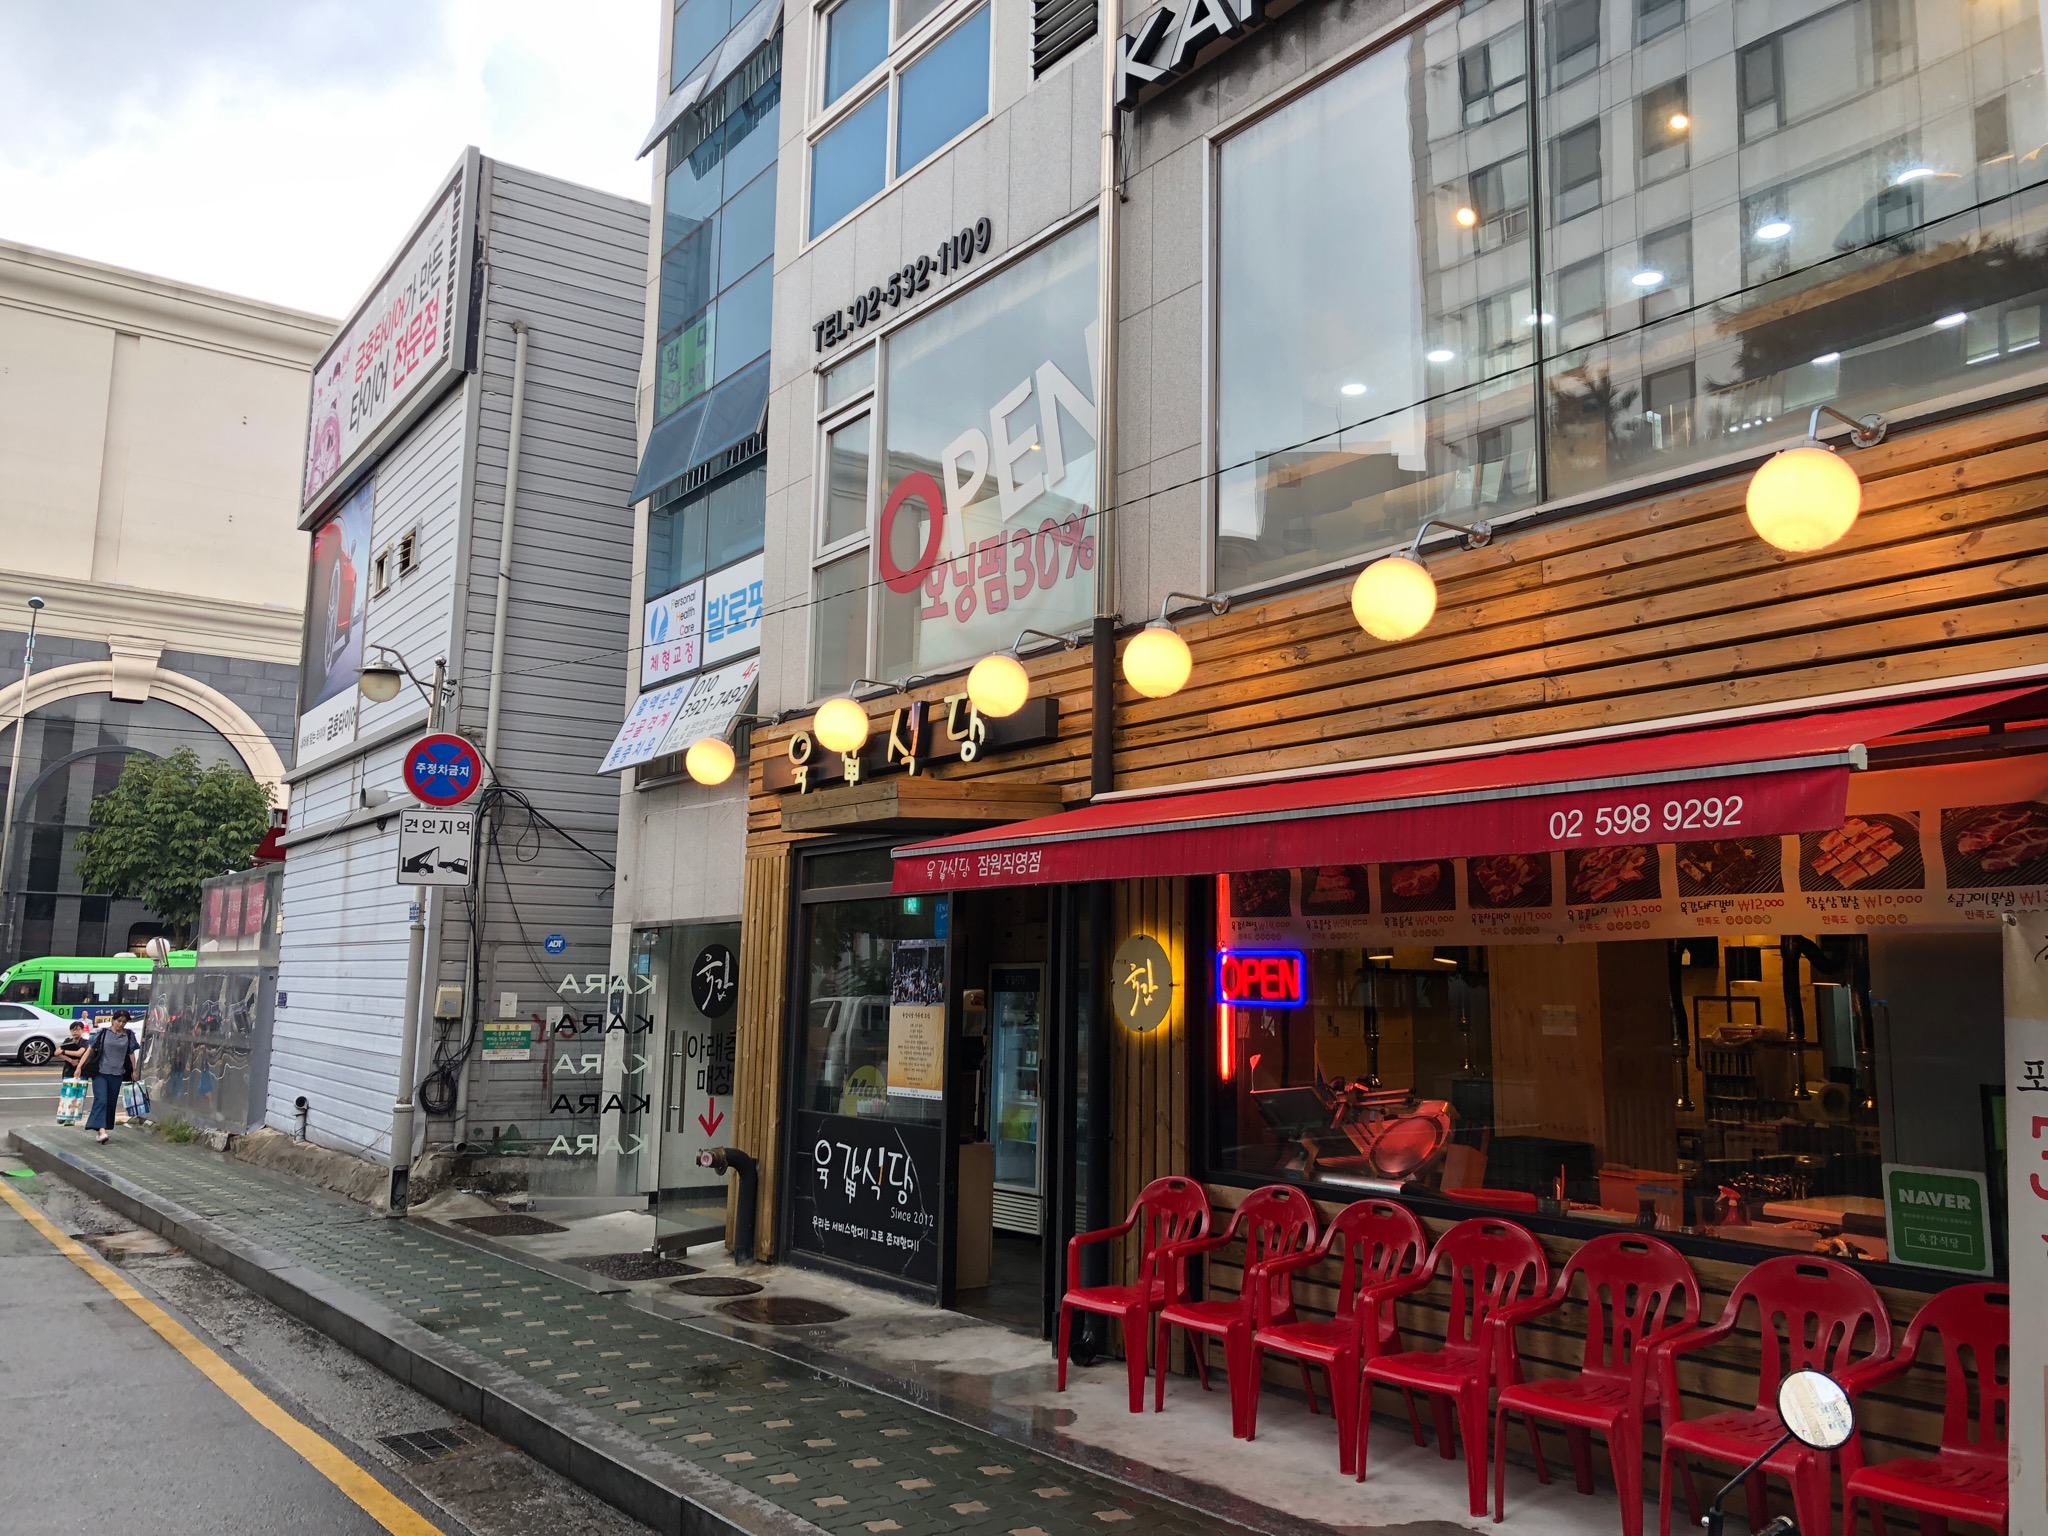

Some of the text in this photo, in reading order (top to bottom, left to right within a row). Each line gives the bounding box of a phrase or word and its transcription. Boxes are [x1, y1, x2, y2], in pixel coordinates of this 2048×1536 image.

[1115, 0, 1258, 106] KA
[354, 273, 417, 385] 금호타이어가
[420, 238, 444, 305] 만든
[349, 348, 390, 433] 타이어
[392, 287, 440, 391] 전문점
[879, 320, 1097, 594] OPEN
[671, 589, 696, 609] Personal
[675, 605, 695, 622] Health
[680, 622, 695, 636] Care
[742, 661, 759, 680] 4F
[693, 674, 719, 698] 010
[679, 684, 748, 720] 3921-7492
[327, 706, 356, 741] 금호타이어
[622, 711, 671, 741] 근골격계
[416, 763, 470, 777] 주정차금지
[404, 818, 470, 836] 견인지역
[1549, 795, 1744, 840] 02 598 9292
[977, 850, 1042, 877] 잠원직영점
[1805, 895, 1860, 911] 참숯삼겹살
[1964, 909, 1996, 920] 만족도
[1696, 916, 1721, 926] 만족도
[1821, 915, 1849, 925] 만족도
[547, 940, 563, 948] ADT
[1220, 956, 1301, 1001] OPEN
[697, 1065, 732, 1095] 매장
[1898, 1188, 1972, 1211] NAVER
[890, 1206, 934, 1227] Since 2012
[812, 1215, 830, 1231] 우리는
[870, 1230, 884, 1242] 고로
[1917, 1232, 1959, 1249] 육갑식당
